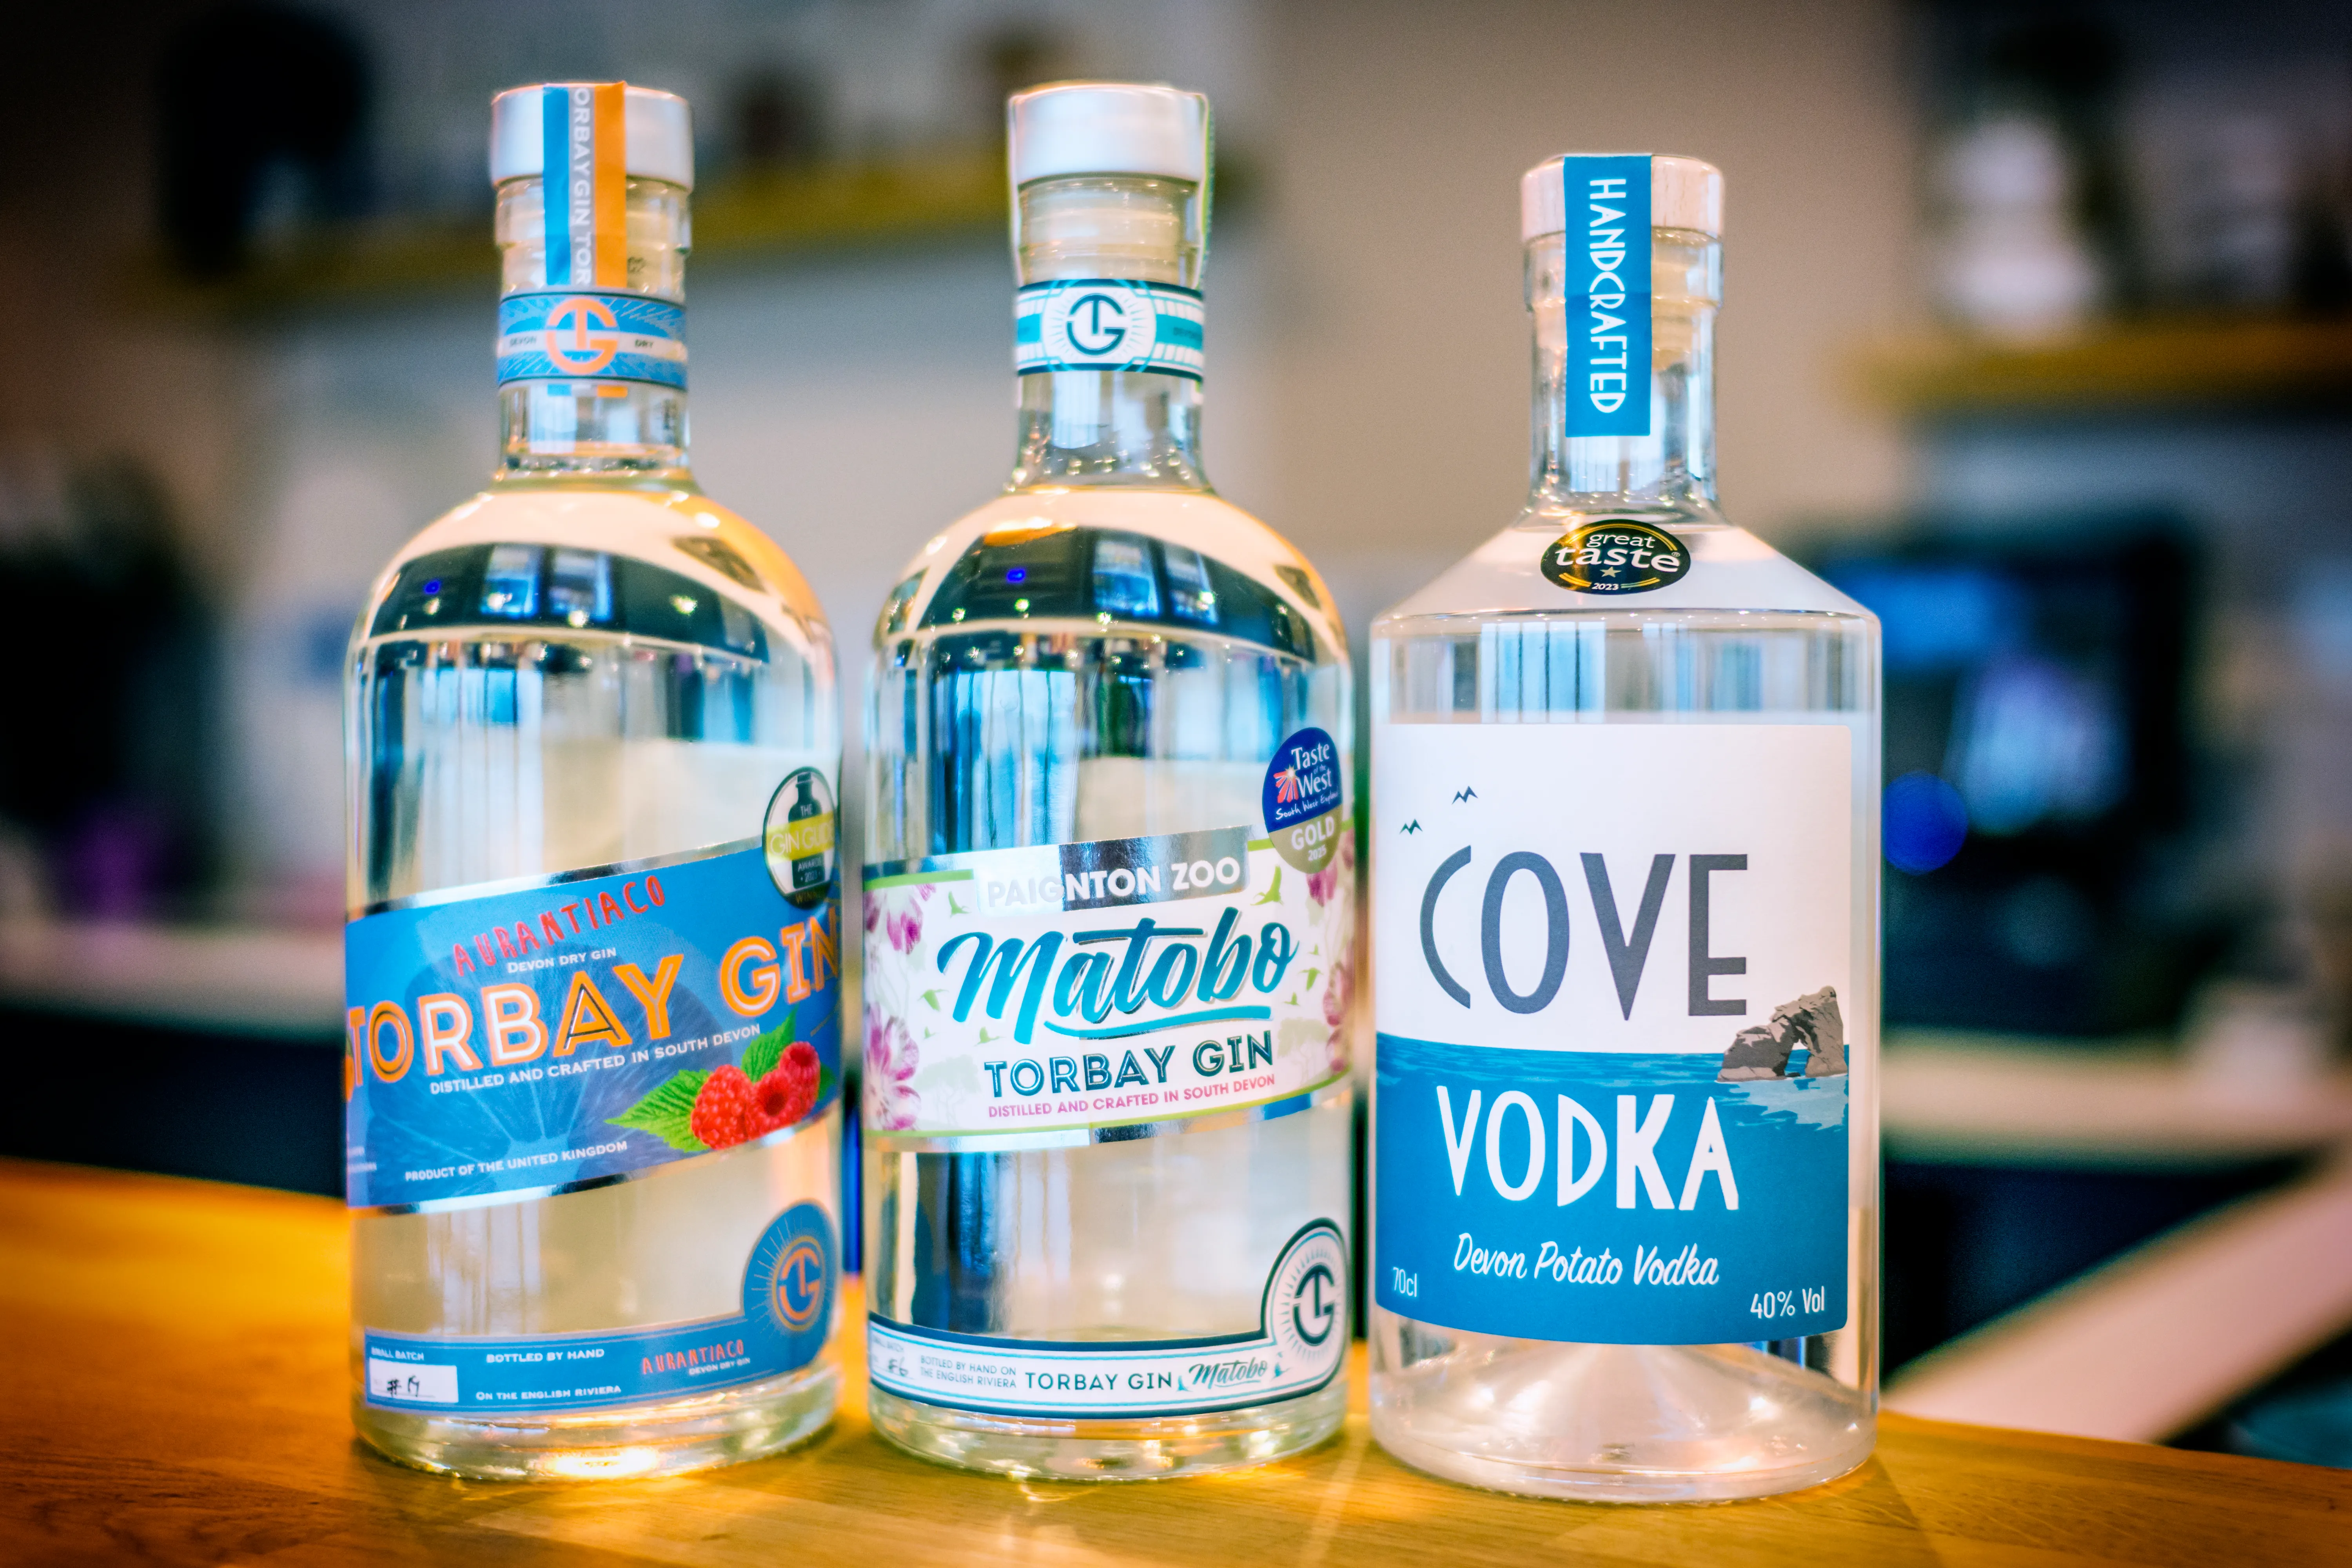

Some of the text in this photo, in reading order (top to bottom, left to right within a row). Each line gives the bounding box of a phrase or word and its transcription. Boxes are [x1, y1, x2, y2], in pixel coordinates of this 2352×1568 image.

[573, 87, 591, 176] ORBAY
[572, 179, 592, 225] GIN
[1589, 179, 1627, 413] HANDCRAFTED
[1586, 534, 1655, 548] great
[1291, 743, 1329, 770] Taste
[1295, 768, 1332, 798] West
[800, 804, 813, 817] THE
[1276, 803, 1301, 820] South
[1302, 799, 1318, 811] West
[770, 820, 833, 856] GIN GUID
[1291, 816, 1334, 850] GOLD
[988, 857, 1240, 907] PAIGNTON ZOO
[453, 875, 666, 976] AURANTIACO
[1420, 844, 1748, 1022] COVE
[508, 947, 617, 973] DEVON DRY GIN
[937, 906, 1299, 1045] Matobo
[349, 907, 838, 1086] TORBAY GIN
[430, 1024, 760, 1094] DISTILLED AND CRAFTED IN SOUTH DEVON
[984, 1030, 1274, 1098] TORBAY GIN
[988, 1074, 1275, 1118] DISTILLED AND CRAFTED IN SOUTH DEVON
[405, 1141, 627, 1181] PRODUCT OF THE UNITED KINGDOM
[1436, 1085, 1739, 1211] VODKA
[1453, 1232, 1720, 1287] Devon Potato Vodka
[1392, 1266, 1417, 1298] 70cl
[1750, 1285, 1825, 1319] 40% Vol
[395, 1350, 425, 1361] BATCH
[486, 1348, 605, 1363] BOTTLED BY HAND
[642, 1339, 744, 1375] AURANTIACO
[920, 1355, 1016, 1376] BOTTLED BY HAND ON
[1188, 1356, 1269, 1390] Matobo
[475, 1385, 622, 1401] ON THE ENGLISH RIVIERA
[936, 1369, 974, 1384] ENGLISH
[977, 1376, 1017, 1388] RIVIERA
[1025, 1372, 1172, 1390] TORBAY GIN
